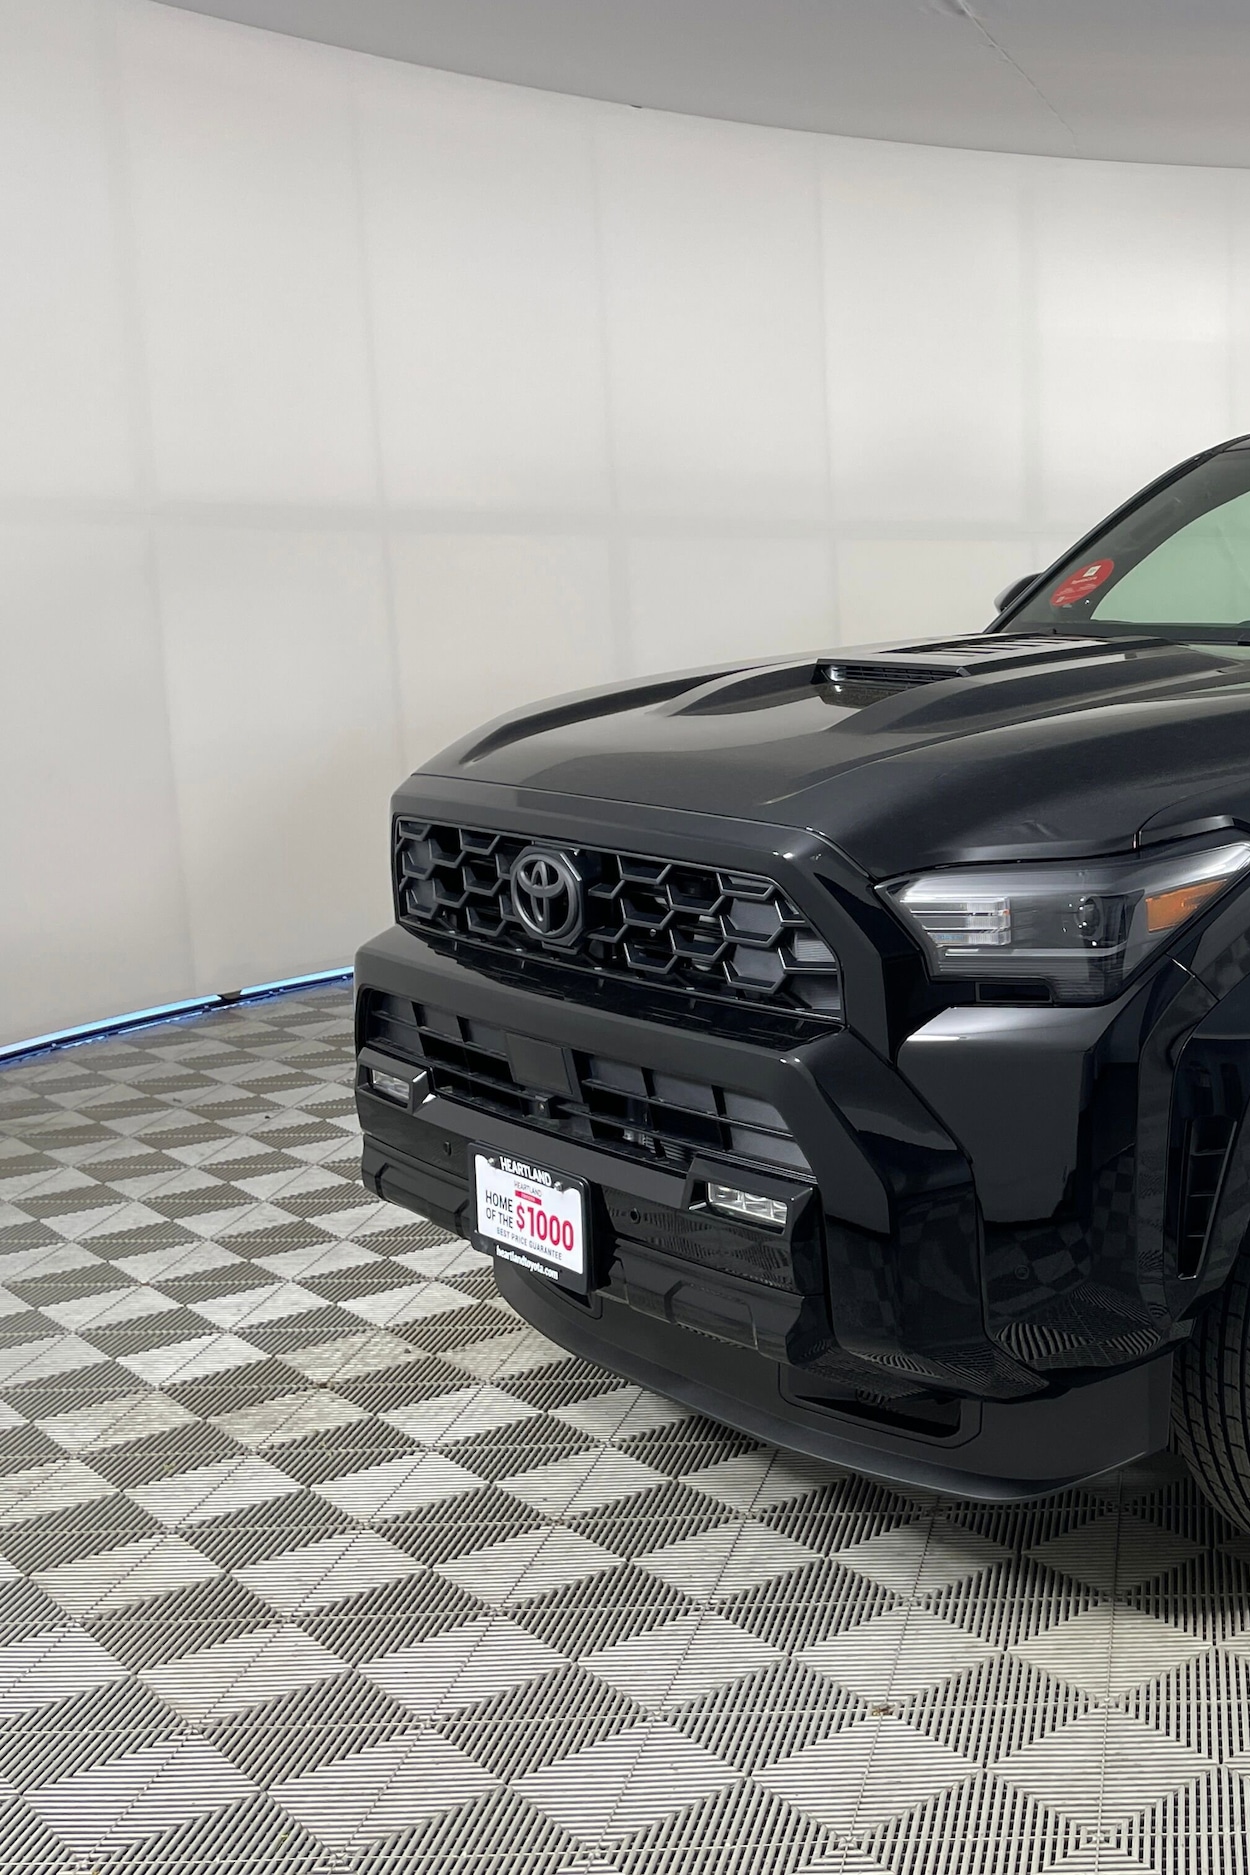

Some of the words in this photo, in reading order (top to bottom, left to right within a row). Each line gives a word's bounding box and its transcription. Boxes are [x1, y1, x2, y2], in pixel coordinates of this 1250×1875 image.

[500, 1156, 552, 1187] HEARTLAND
[485, 1189, 514, 1213] HOME
[514, 1180, 542, 1198] HEARTLAND
[486, 1207, 497, 1222] OF
[499, 1212, 514, 1229] THE
[516, 1203, 574, 1252] $1000
[497, 1227, 510, 1238] BEST
[511, 1233, 528, 1246] PRICE
[529, 1240, 562, 1261] GUARANTEE
[496, 1245, 559, 1281] heartlandtoyota.com
